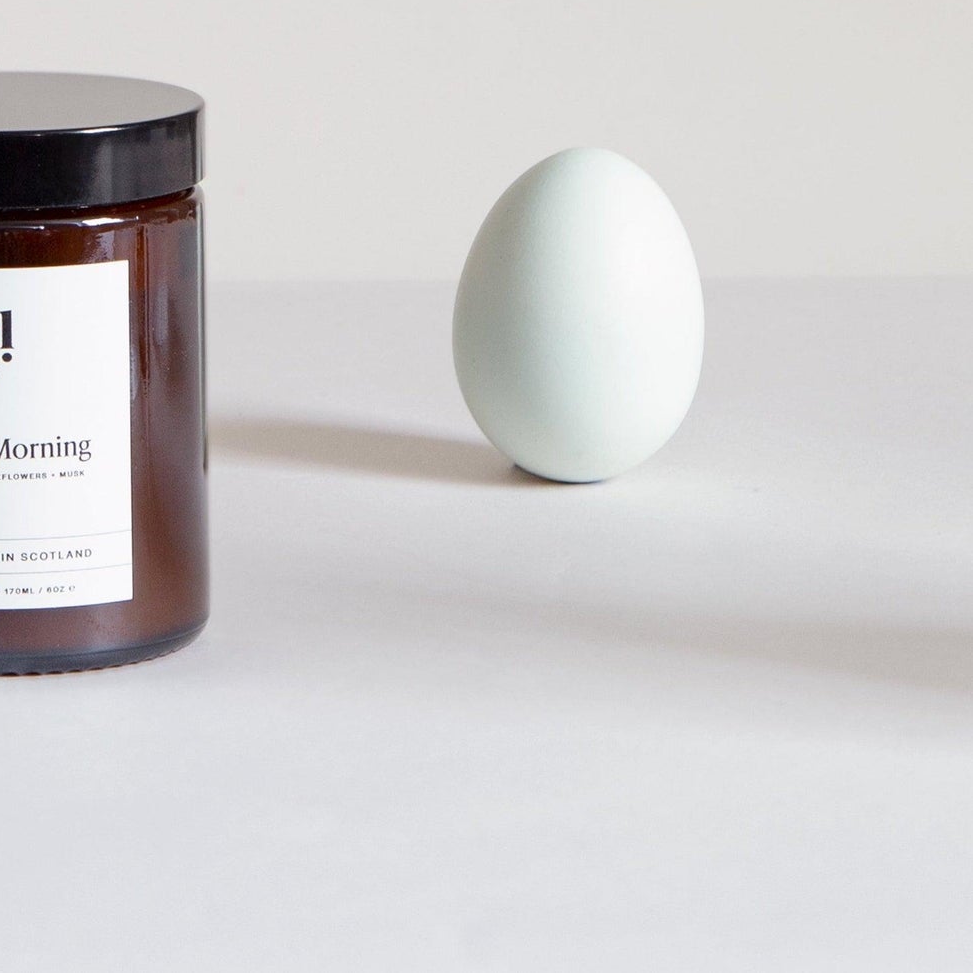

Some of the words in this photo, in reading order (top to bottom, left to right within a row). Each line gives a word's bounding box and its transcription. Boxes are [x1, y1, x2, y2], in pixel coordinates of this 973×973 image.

[59, 469, 86, 478] MUSK
[0, 552, 16, 562] IN
[20, 548, 93, 562] SCOTLAND
[3, 586, 35, 595] 170ML
